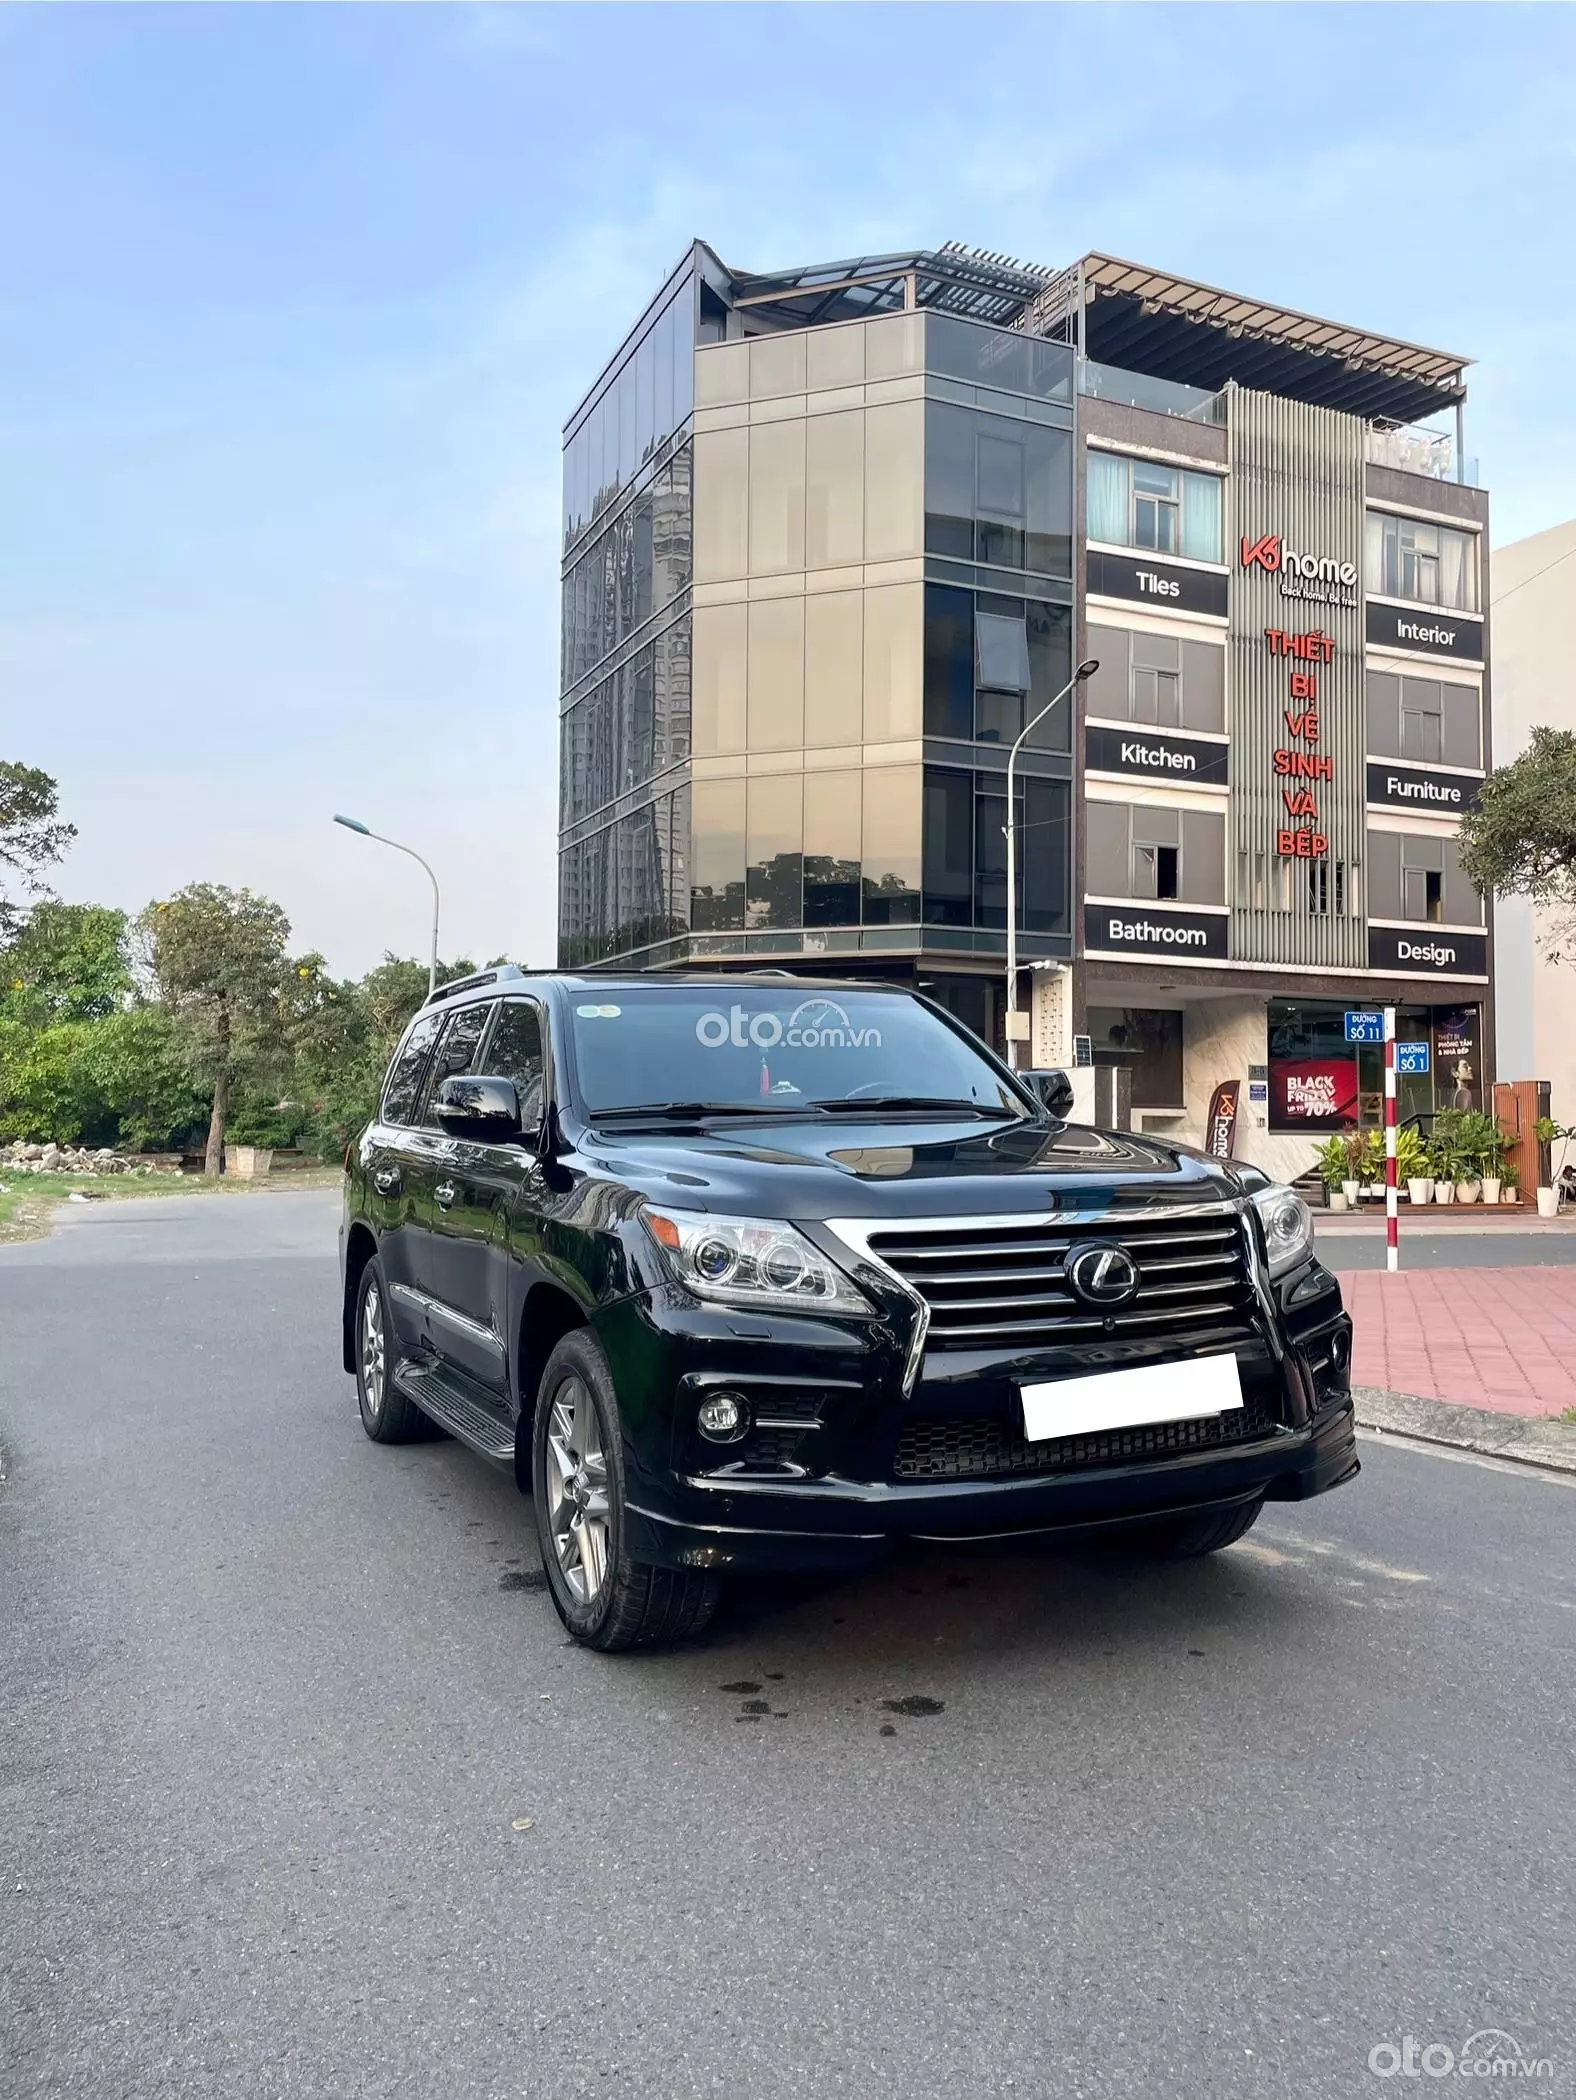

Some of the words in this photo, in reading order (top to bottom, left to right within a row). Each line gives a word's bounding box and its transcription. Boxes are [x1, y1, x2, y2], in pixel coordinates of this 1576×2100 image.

[1136, 571, 1181, 597] Tiles
[1281, 584, 1302, 597] Back
[1329, 593, 1340, 604] Be
[1397, 619, 1456, 646] Interior
[1266, 629, 1335, 663] THIẾT
[1291, 672, 1317, 706] BỊ
[1286, 708, 1320, 744] VỆ
[1121, 743, 1196, 771] Kitchen
[1274, 749, 1333, 781] SINH
[1387, 777, 1462, 803] Furniture
[1284, 789, 1318, 818] VÀ
[1277, 826, 1329, 857] BẾP
[1109, 920, 1207, 946] Bathroom
[1397, 941, 1456, 967] Design
[1350, 1023, 1365, 1039] SỐ
[1369, 1027, 1380, 1039] 11
[1401, 1054, 1416, 1070] SỐ
[1420, 1058, 1425, 1070] 1
[1287, 1075, 1335, 1090] BLACK
[1287, 1089, 1336, 1103] FRIDAY
